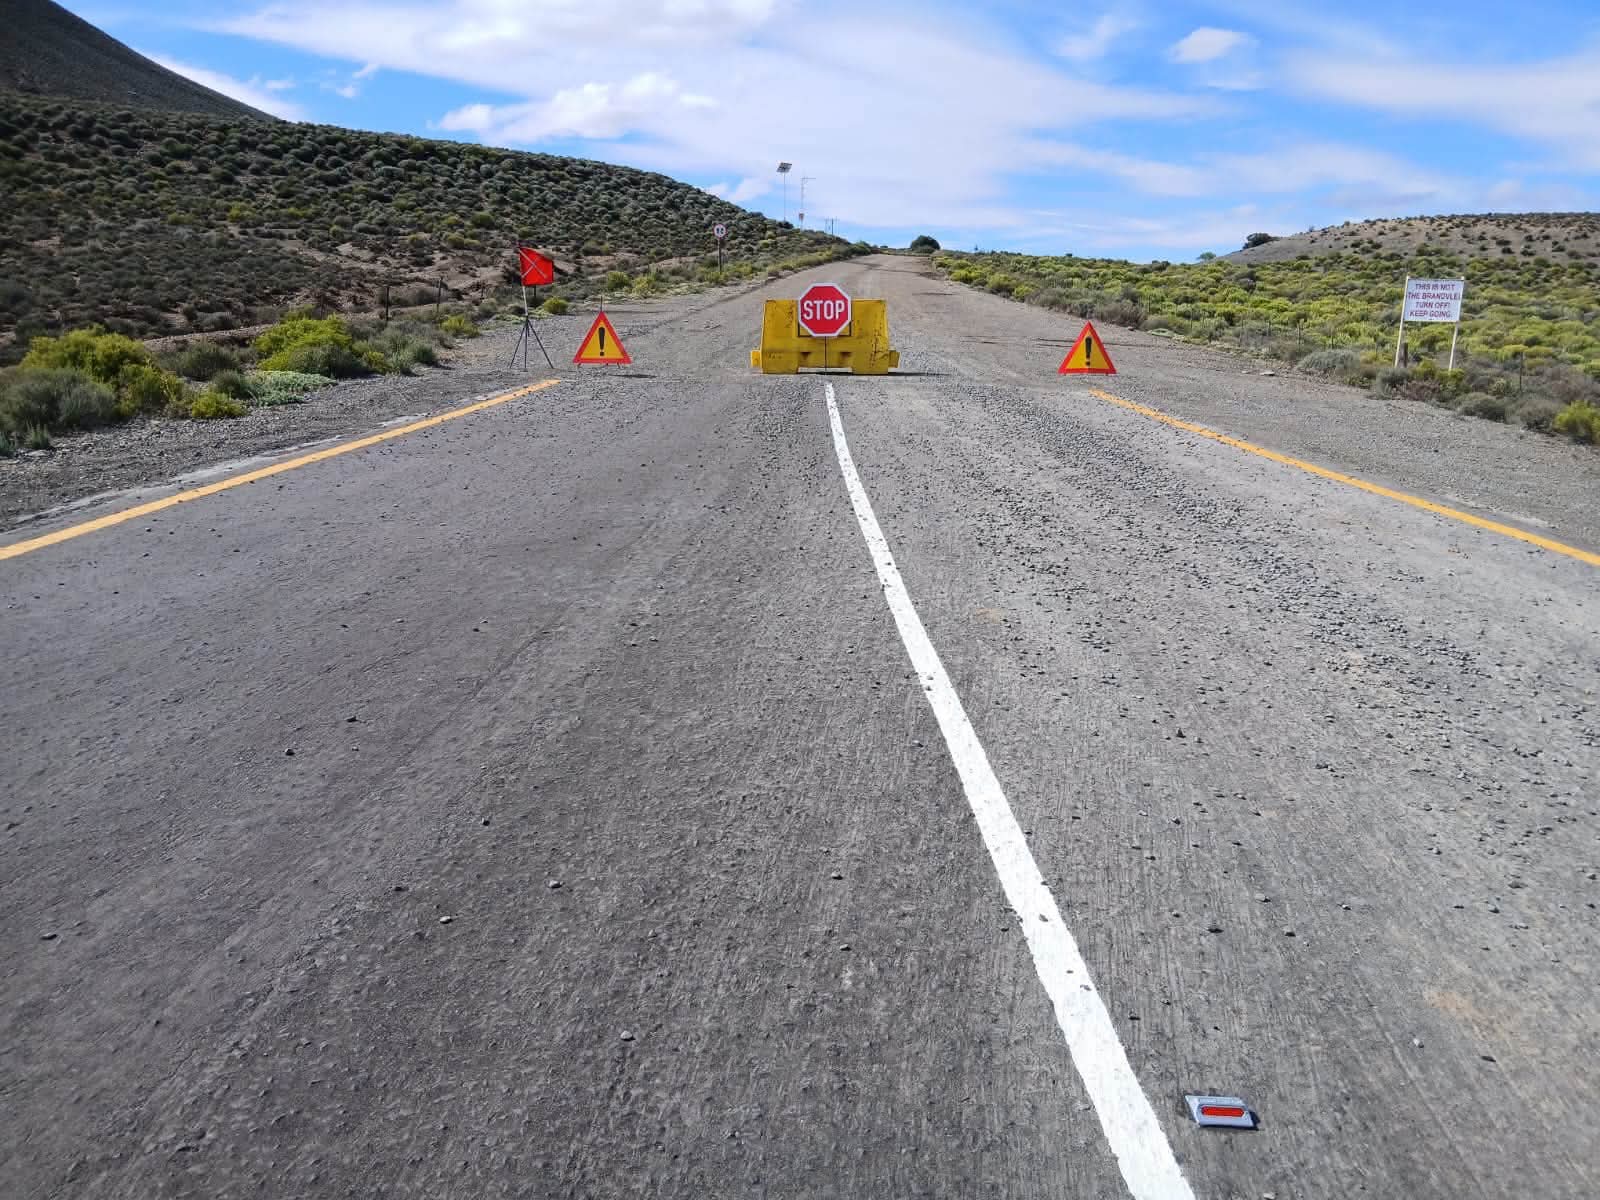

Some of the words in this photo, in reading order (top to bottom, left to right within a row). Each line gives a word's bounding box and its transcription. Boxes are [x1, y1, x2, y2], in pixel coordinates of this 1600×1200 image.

[1415, 283, 1430, 291] THIS
[1432, 283, 1439, 291] IS
[1440, 283, 1456, 291] NOT
[1408, 292, 1421, 300] THE
[1415, 301, 1433, 309] TURN
[803, 300, 845, 320] STOP
[1409, 309, 1428, 317] KEEP
